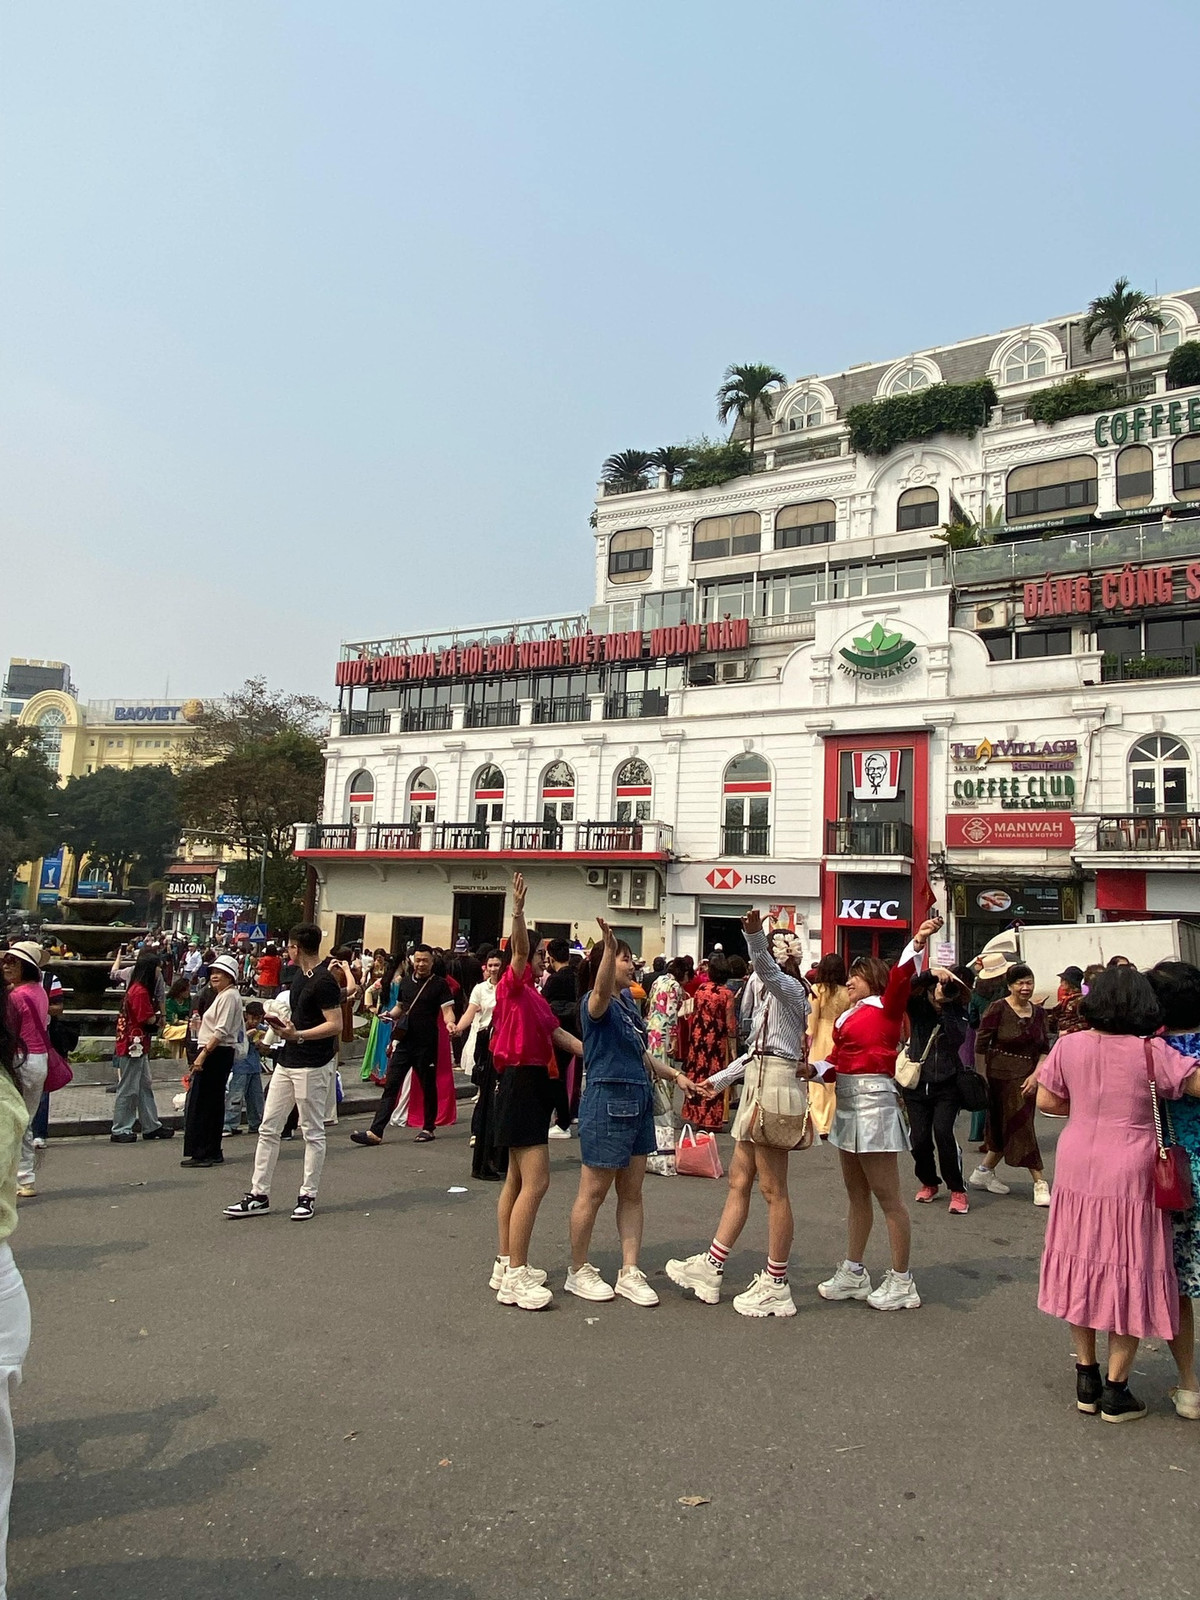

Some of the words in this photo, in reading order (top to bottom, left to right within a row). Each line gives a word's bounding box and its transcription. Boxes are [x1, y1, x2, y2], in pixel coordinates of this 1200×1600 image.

[1095, 397, 1200, 448] COFFEE
[1125, 506, 1164, 516] Breakfast
[1003, 522, 1045, 533] Vietnamese
[1102, 562, 1174, 616] CỘNG
[603, 630, 643, 662] NAM
[650, 619, 701, 658] MUÔN
[706, 612, 749, 650] NĂM
[837, 656, 918, 681] PHYTOPHARCO
[953, 777, 1021, 799] COFFEE
[994, 822, 1063, 832] MANWAH
[744, 874, 777, 885] HSBC
[838, 899, 901, 921] KFC
[707, 1255, 723, 1269] 123
